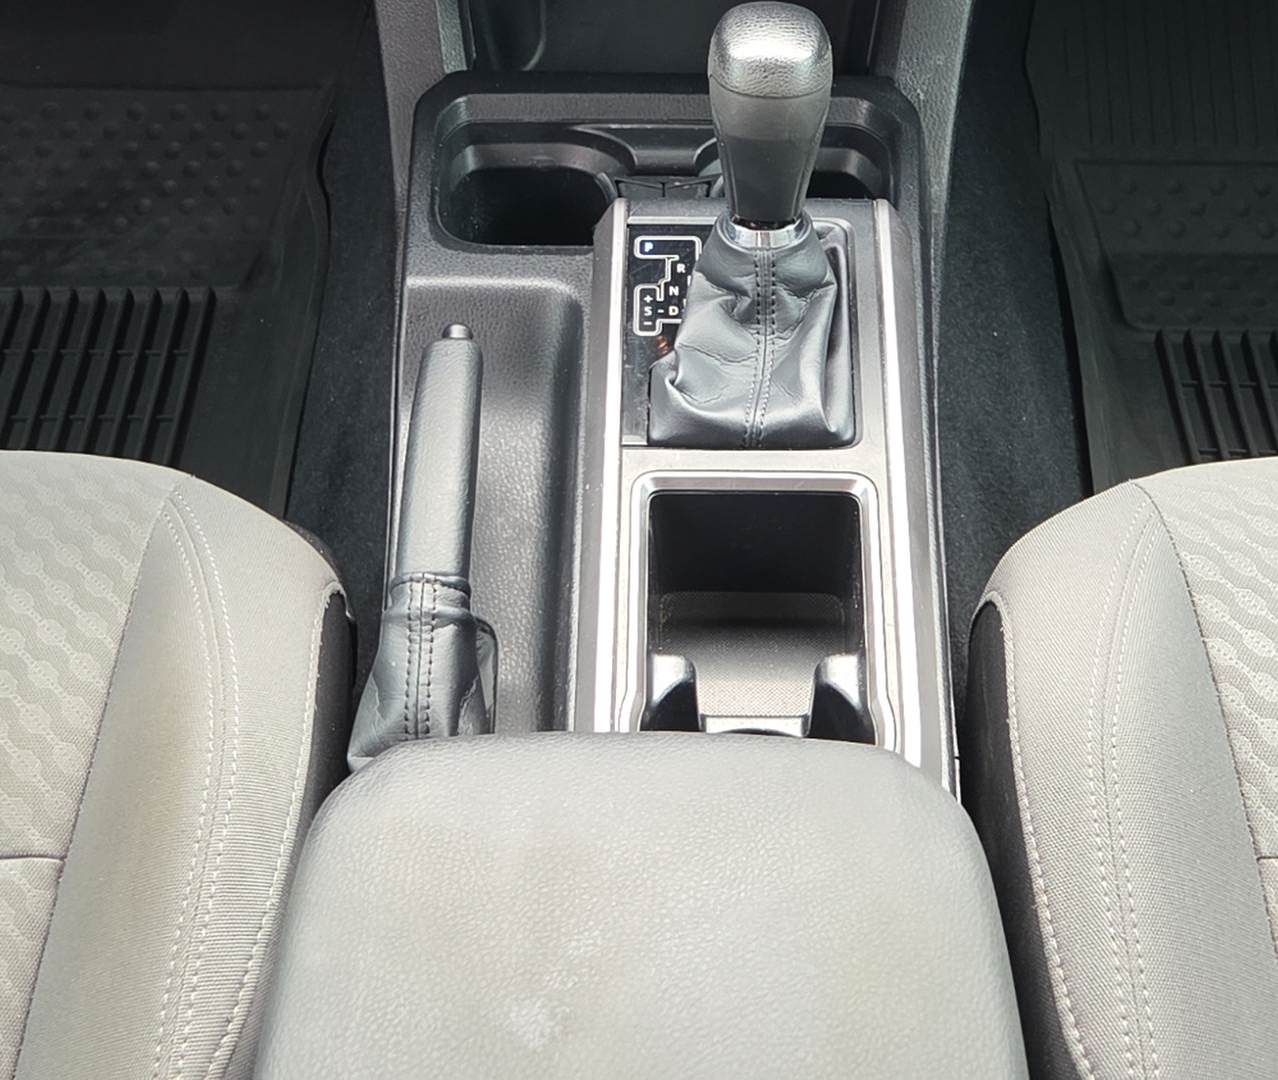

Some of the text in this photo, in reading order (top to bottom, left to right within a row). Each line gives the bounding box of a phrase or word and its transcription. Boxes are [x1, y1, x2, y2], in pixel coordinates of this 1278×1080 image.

[644, 241, 654, 253] P
[676, 263, 687, 274] R
[668, 285, 680, 297] N
[643, 305, 679, 317] S D
